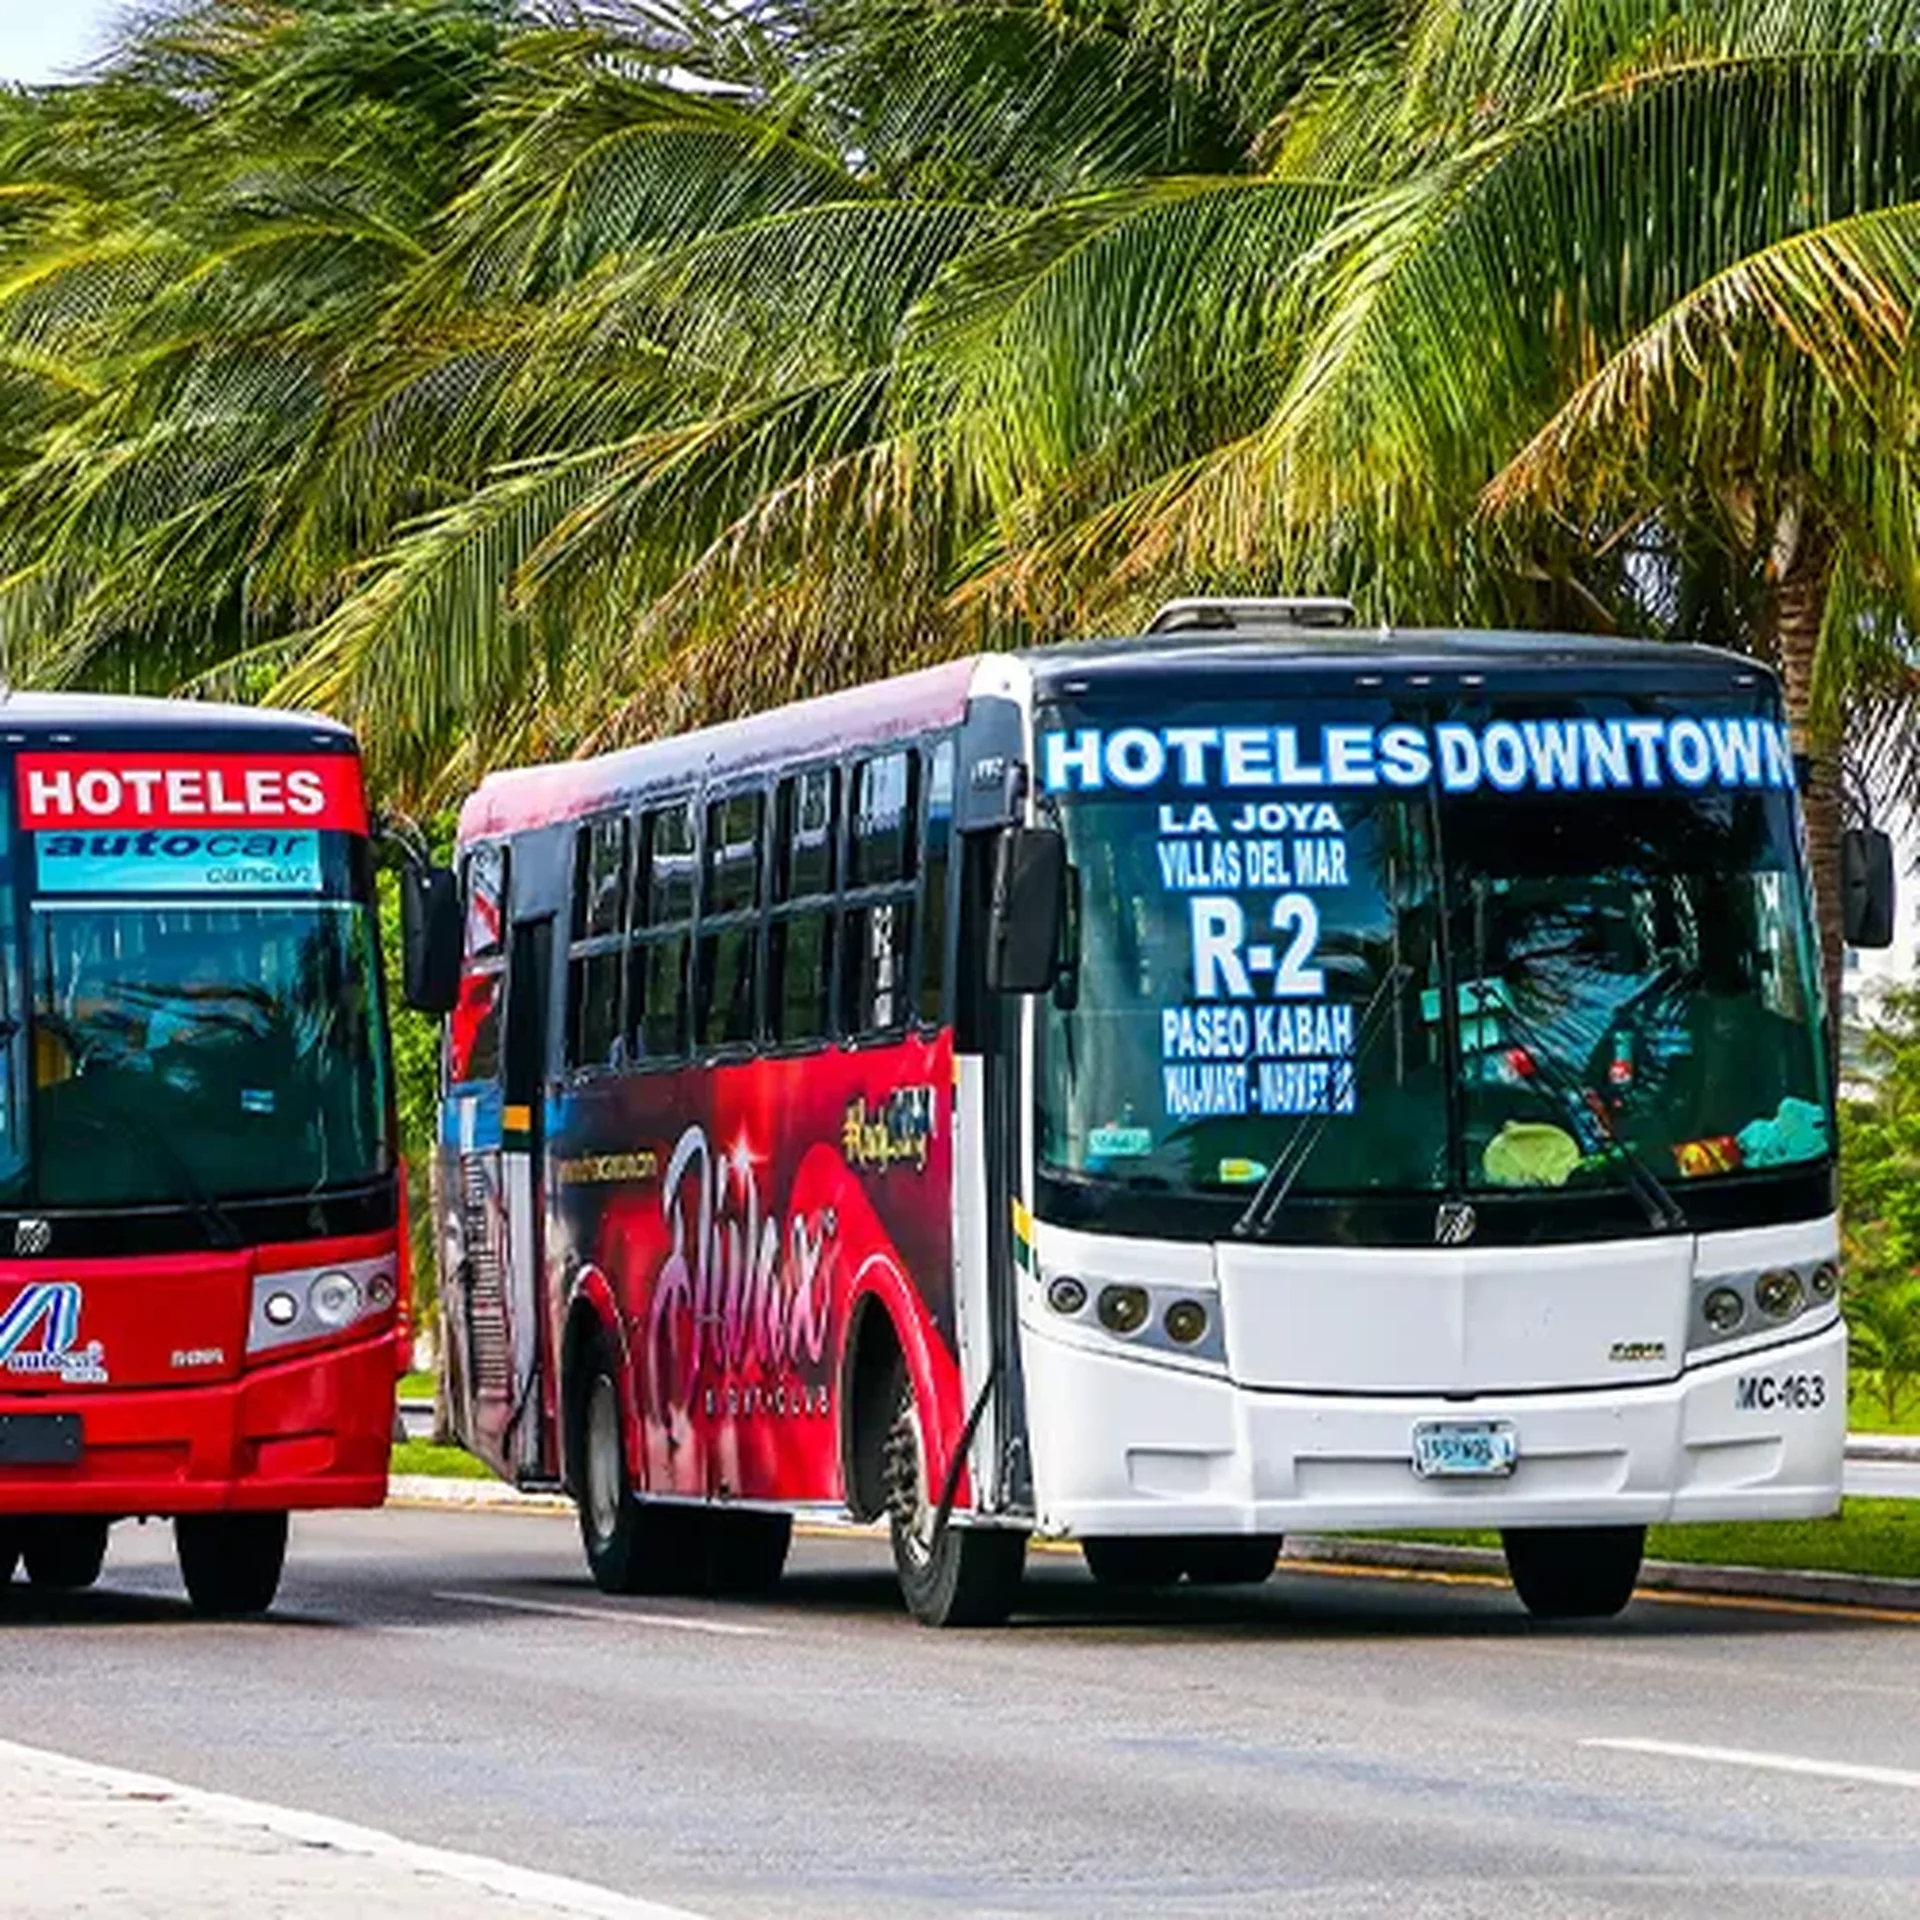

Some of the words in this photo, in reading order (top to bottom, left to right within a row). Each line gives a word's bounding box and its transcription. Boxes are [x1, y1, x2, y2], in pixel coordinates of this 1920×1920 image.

[1045, 726, 1430, 790] HOTELES
[1435, 717, 1797, 793] DOWNTOWN
[28, 769, 325, 816] HOTELES
[1159, 804, 1220, 834] LA
[1231, 803, 1345, 833] JOYA
[44, 831, 309, 858] autocar
[1156, 840, 1242, 890] VILLAS
[1245, 840, 1291, 886] DEL
[1292, 839, 1349, 886] MAR
[1188, 892, 1326, 998] R-2
[1161, 1007, 1249, 1058] PASEO
[1252, 1003, 1353, 1057] KABAH
[1735, 1374, 1826, 1411] MC-163
